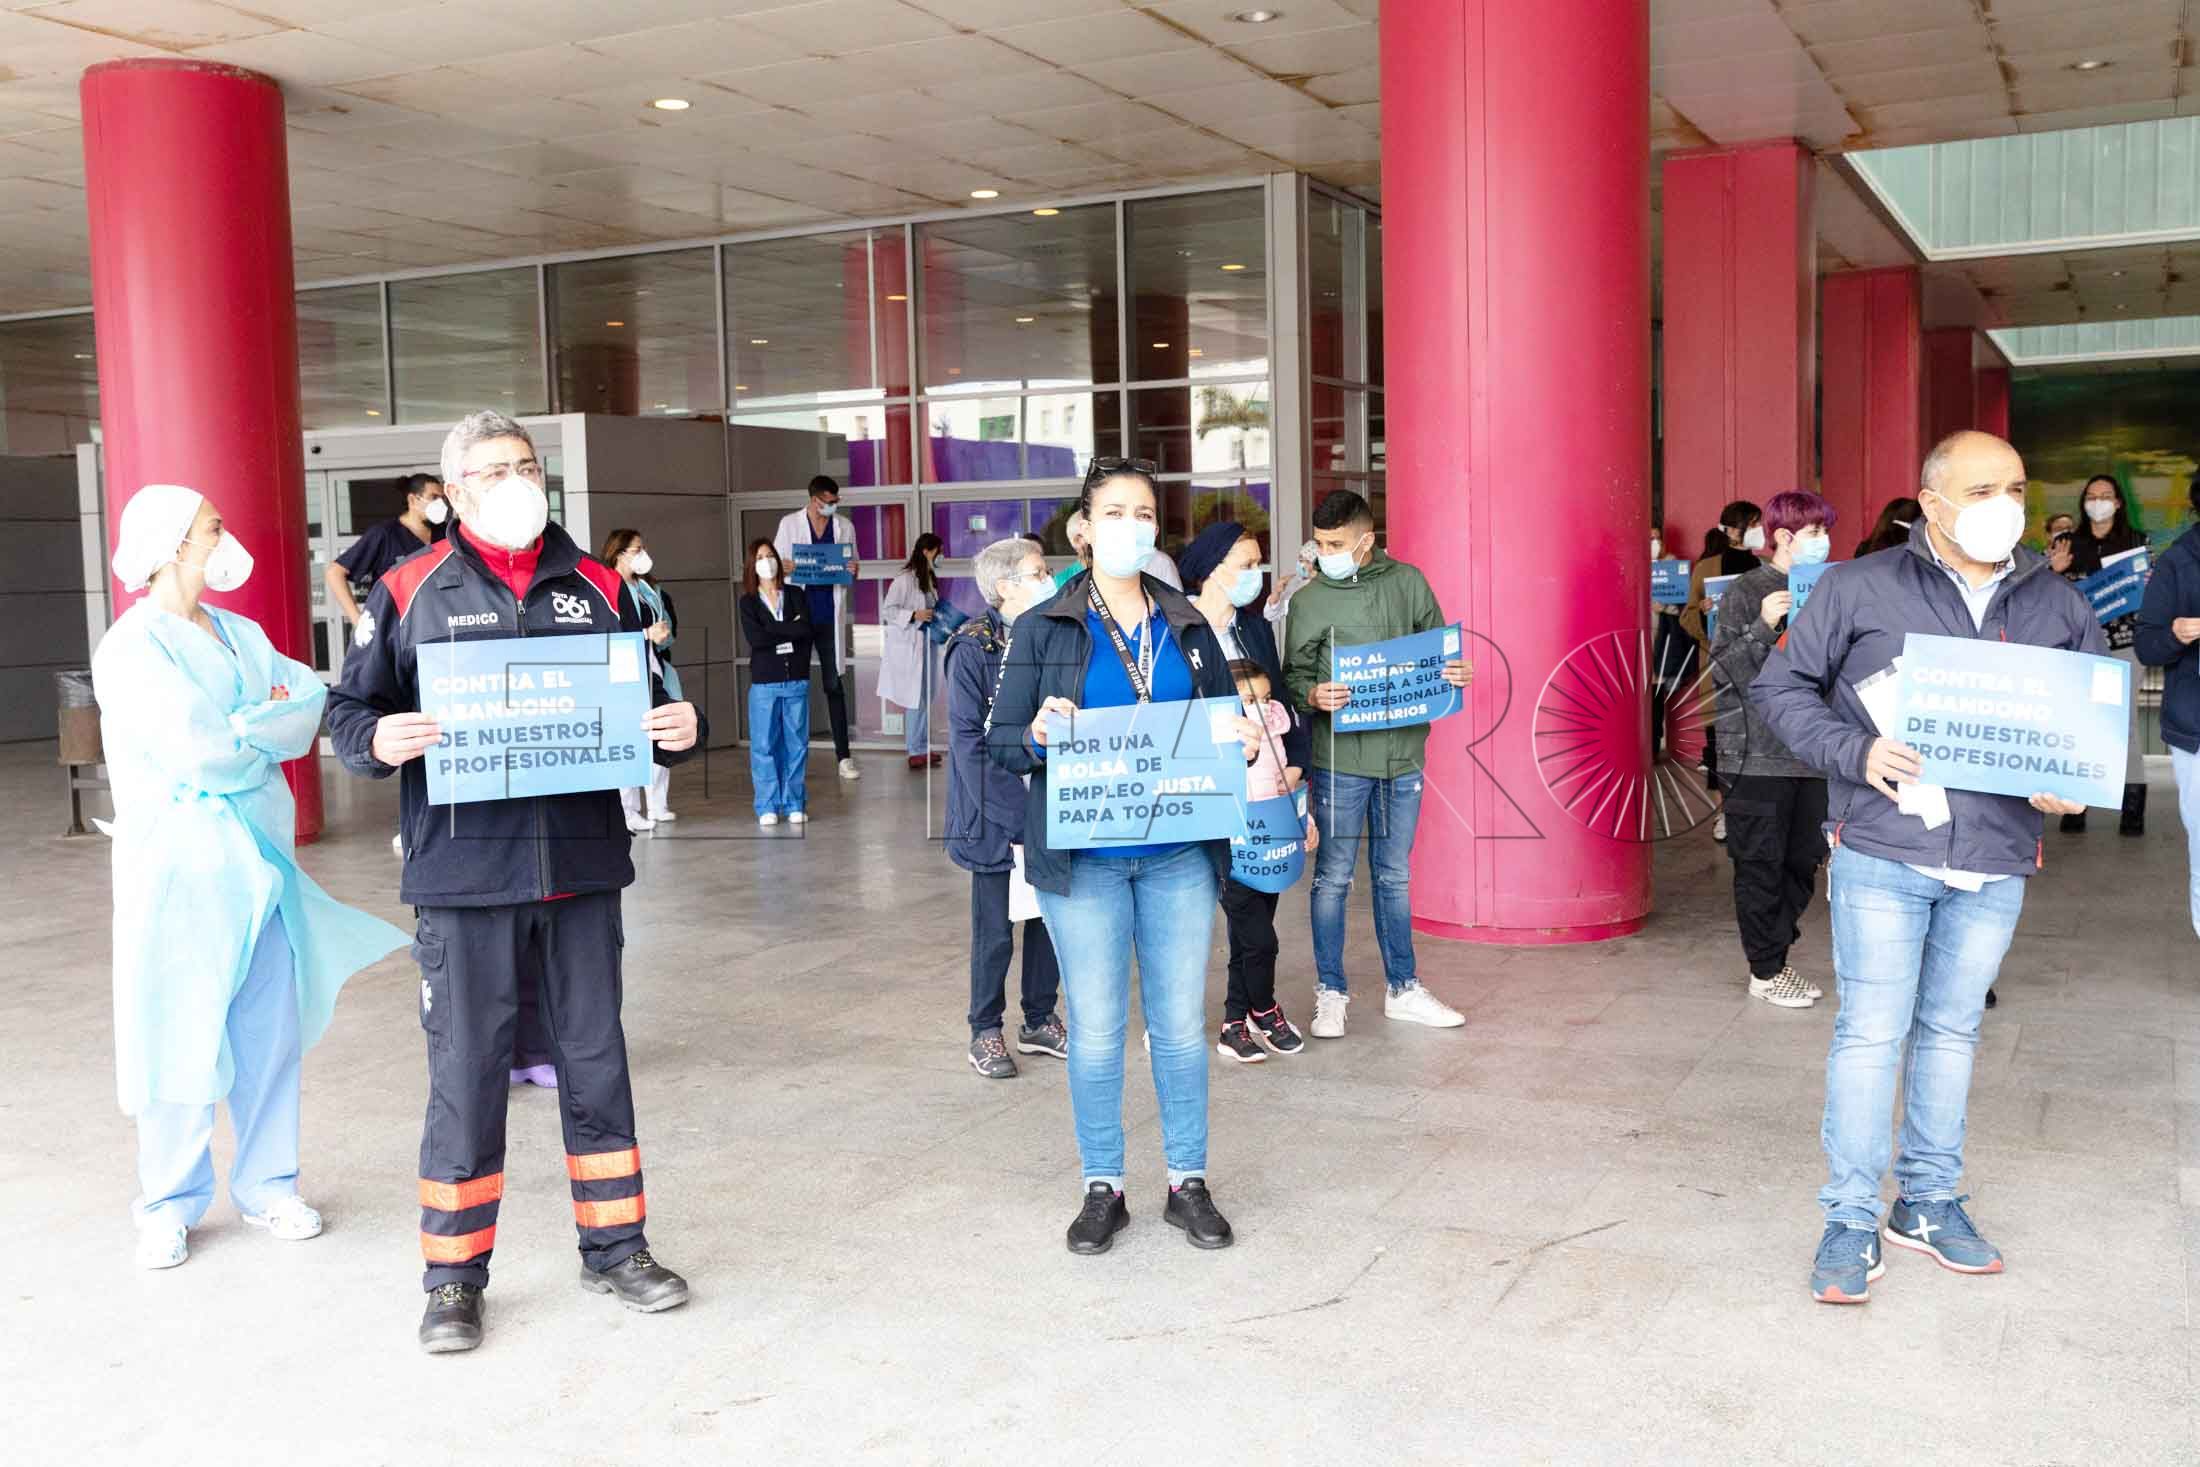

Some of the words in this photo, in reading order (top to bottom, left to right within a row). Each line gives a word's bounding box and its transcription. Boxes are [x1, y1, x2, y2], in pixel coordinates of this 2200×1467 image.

[552, 594, 592, 619] 061
[447, 611, 499, 628] MEDICO
[1339, 655, 1362, 668] NO
[1366, 652, 1387, 665] AL
[1340, 661, 1416, 682] MALTRATO
[1420, 655, 1446, 669] DEL
[432, 672, 535, 697] CONTRA
[542, 670, 573, 689] EL
[1347, 681, 1397, 695] NGESA
[1401, 677, 1411, 689] A
[1415, 670, 1442, 685] SUS
[433, 695, 577, 721] ABANDONO
[1340, 703, 1429, 725] SANITARIOS
[438, 730, 468, 749] DE
[478, 720, 605, 746] NUESTROS
[1058, 738, 1101, 756] POR
[1109, 733, 1155, 751] UNA
[1906, 716, 1937, 734] DE
[1946, 720, 2077, 751] NUESTROS
[439, 743, 637, 776] PROFESIONALES
[1057, 759, 1129, 779] BOLSA
[1136, 757, 1162, 773] DE
[1058, 782, 1145, 801] EMPLEO
[1152, 775, 1217, 795] JUSTA
[1058, 807, 1115, 824] PARA
[1123, 801, 1194, 820] TODOS
[1246, 819, 1267, 831] NA
[1252, 834, 1272, 846] DE
[1262, 841, 1298, 862] JUSTA
[1241, 862, 1289, 876] TODOS
